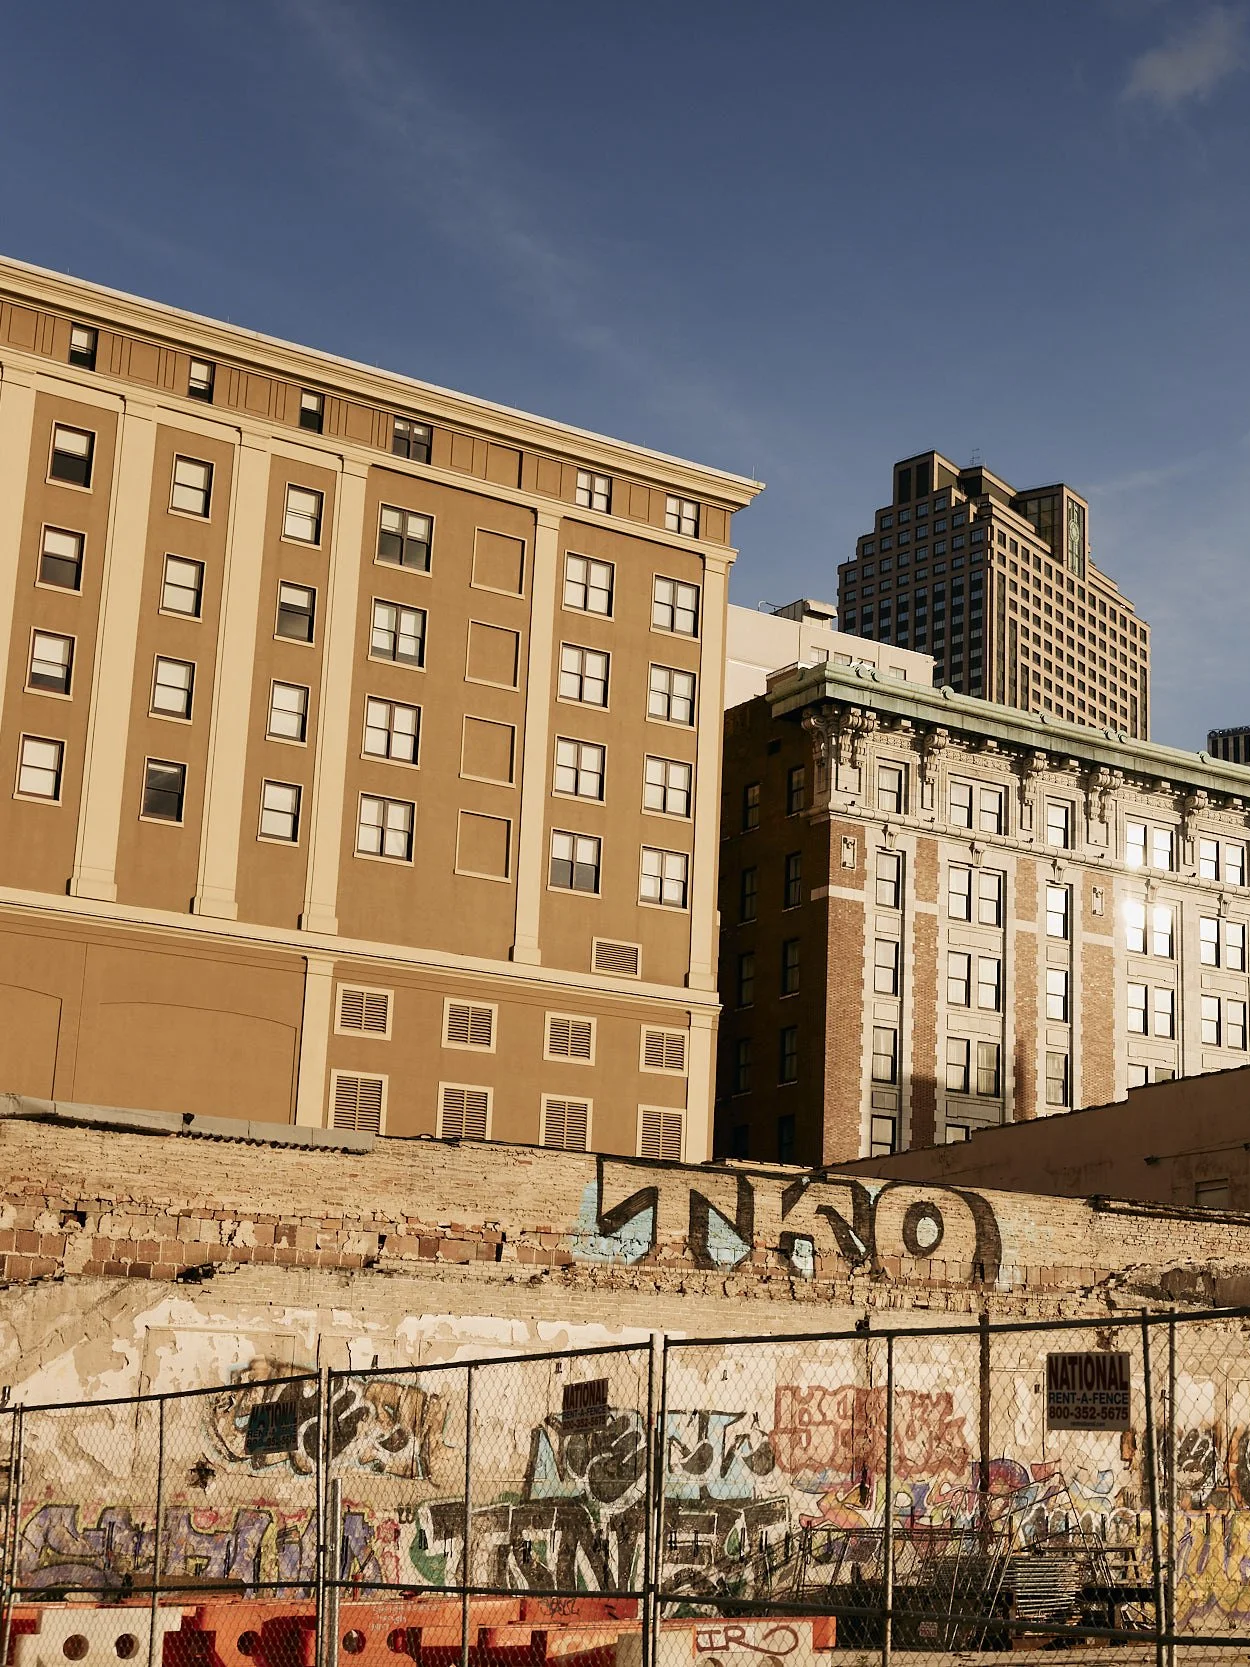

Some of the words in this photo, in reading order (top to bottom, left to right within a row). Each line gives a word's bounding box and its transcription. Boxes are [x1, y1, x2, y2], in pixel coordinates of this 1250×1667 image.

[1048, 1355, 1128, 1391] NATIONAL
[562, 1380, 608, 1410] NATIONAL
[1048, 1392, 1129, 1404] RENT-A-FENCE
[1049, 1406, 1129, 1420] 800-352-5675
